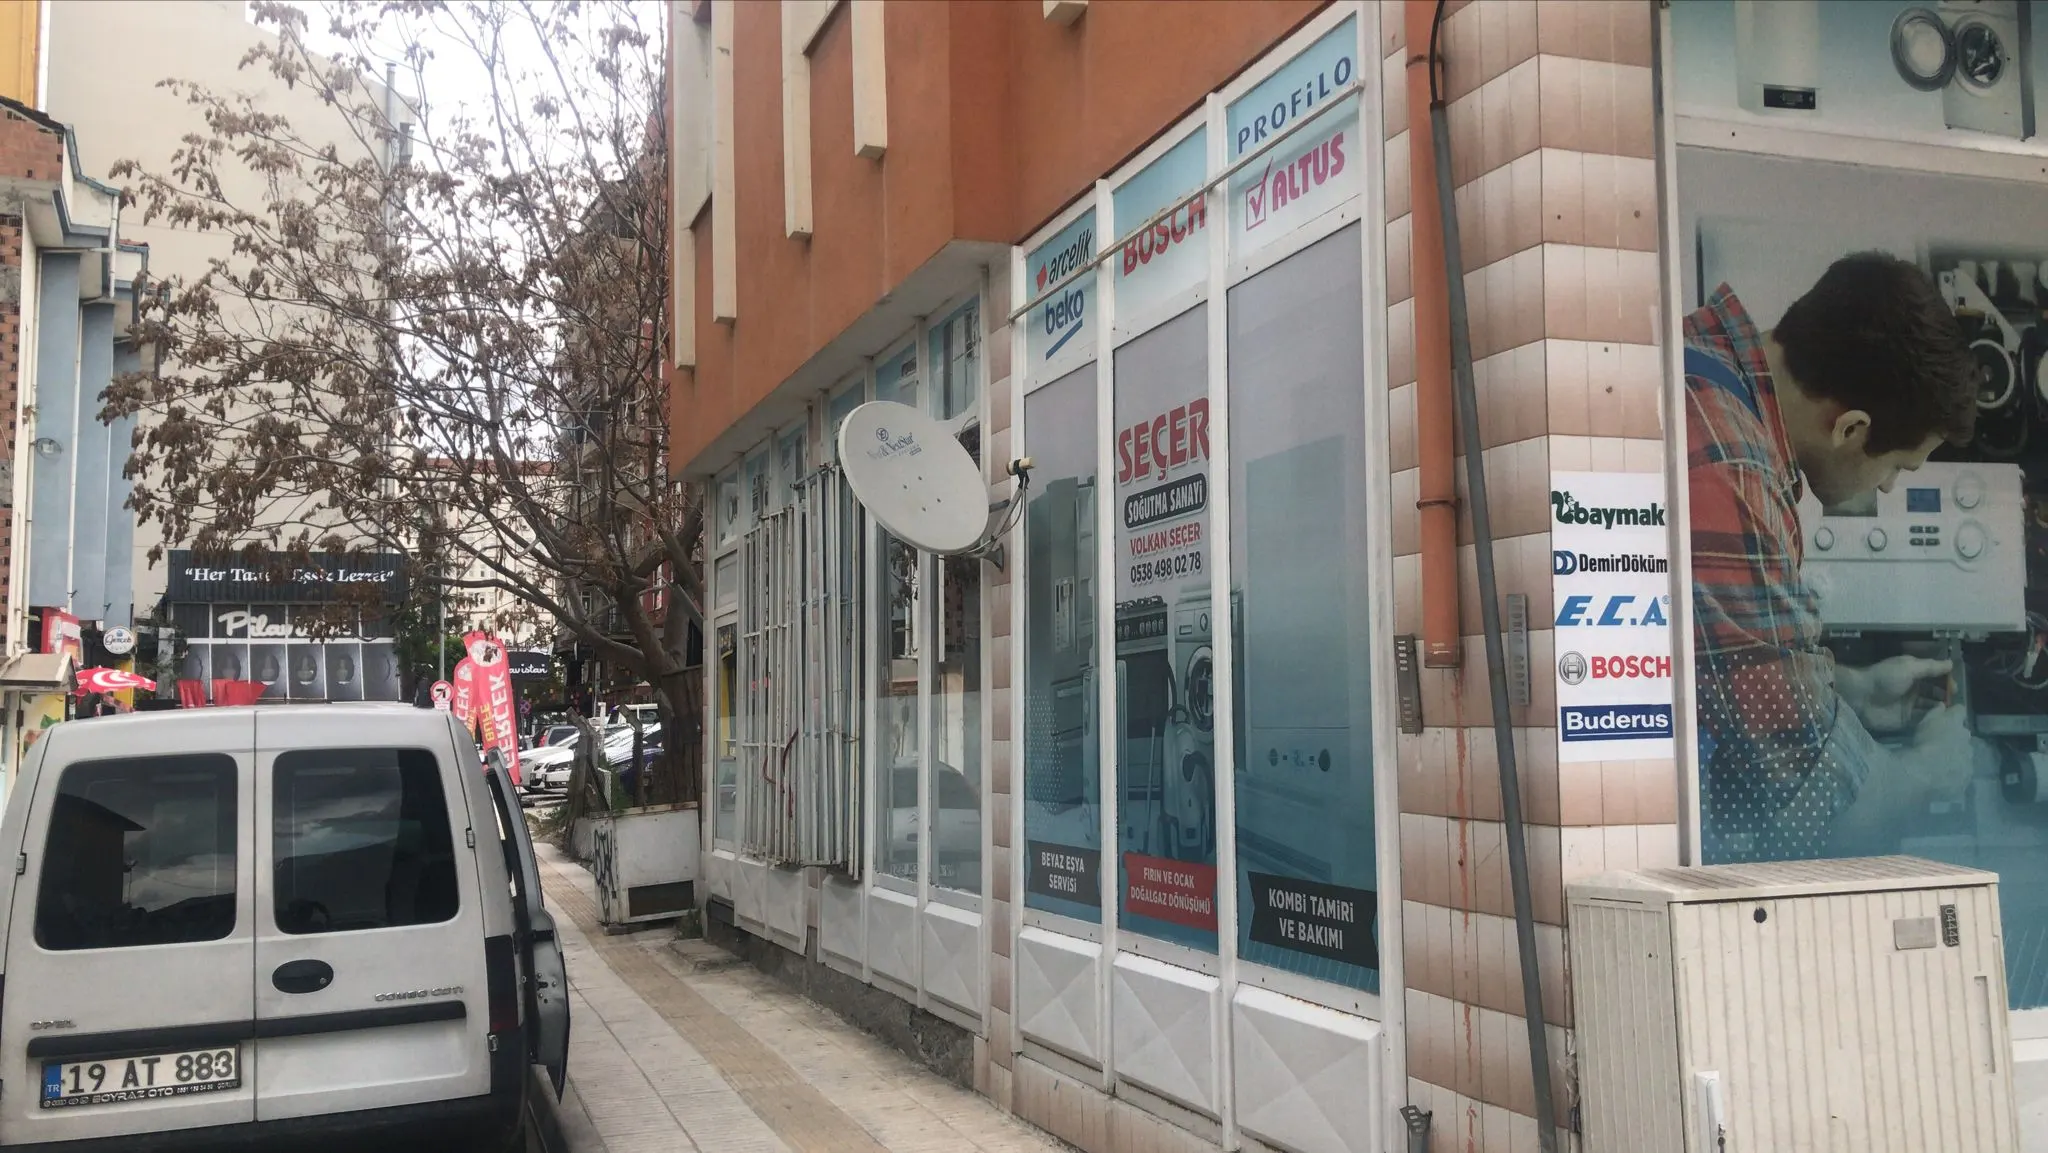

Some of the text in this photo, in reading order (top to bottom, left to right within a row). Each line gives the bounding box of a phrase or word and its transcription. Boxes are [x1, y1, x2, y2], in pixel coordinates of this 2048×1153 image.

[1272, 132, 1345, 212] ALTUS
[1123, 193, 1206, 277] BOSCH
[1045, 288, 1085, 335] beko
[1118, 397, 1210, 485] SEÇER
[1127, 491, 1168, 524] SOĞUTMA
[1574, 502, 1666, 530] baymak
[1130, 522, 1201, 556] VOLKAN SEÇER
[1130, 550, 1202, 583] 0538 498 02 78
[1578, 553, 1668, 575] DemirDöküm
[1591, 655, 1672, 680] BOSCH
[1566, 711, 1669, 731] Buderus
[1041, 850, 1086, 875] BEYAZ EŞYA
[1143, 866, 1195, 888] FIRIN VE OCAK
[1130, 884, 1211, 915] DOĞALGAZ DÖNÜŞÜMÜ
[1278, 917, 1344, 951] VE BAKIMI
[47, 1050, 233, 1094] TR 19 AT 883
[147, 1087, 174, 1098] OTO
